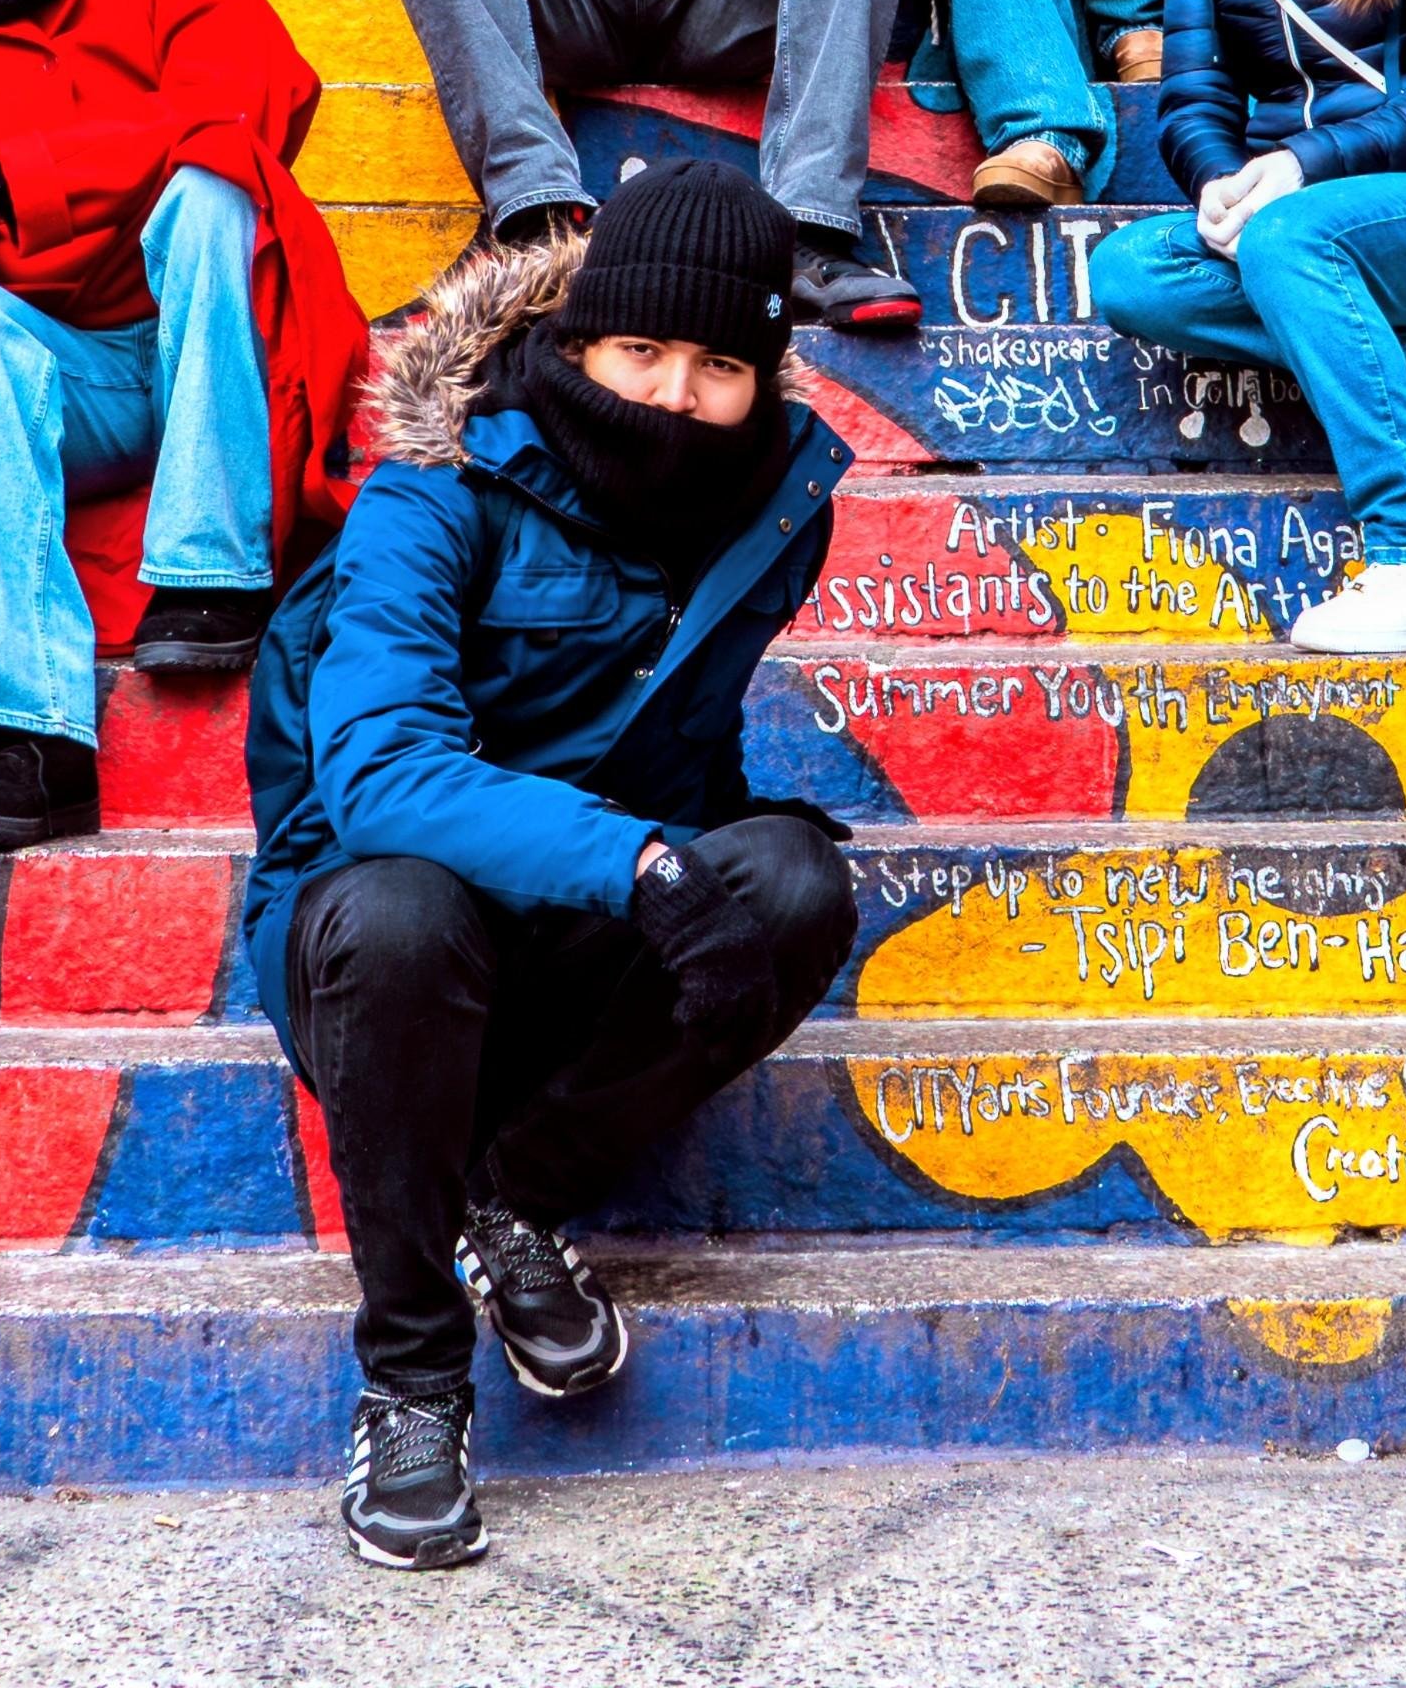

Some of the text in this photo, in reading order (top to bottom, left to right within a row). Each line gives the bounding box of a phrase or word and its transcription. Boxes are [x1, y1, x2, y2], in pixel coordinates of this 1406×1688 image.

[951, 219, 1133, 328] CIT
[1136, 376, 1173, 411] In
[1142, 498, 1258, 570] Fiona
[1063, 563, 1109, 615] to
[1121, 566, 1199, 616] the
[812, 662, 1025, 736] Summer
[1031, 660, 1189, 733] Youth
[1041, 854, 1086, 899] to
[1106, 862, 1209, 906] new
[1049, 905, 1188, 1001] Tsipi
